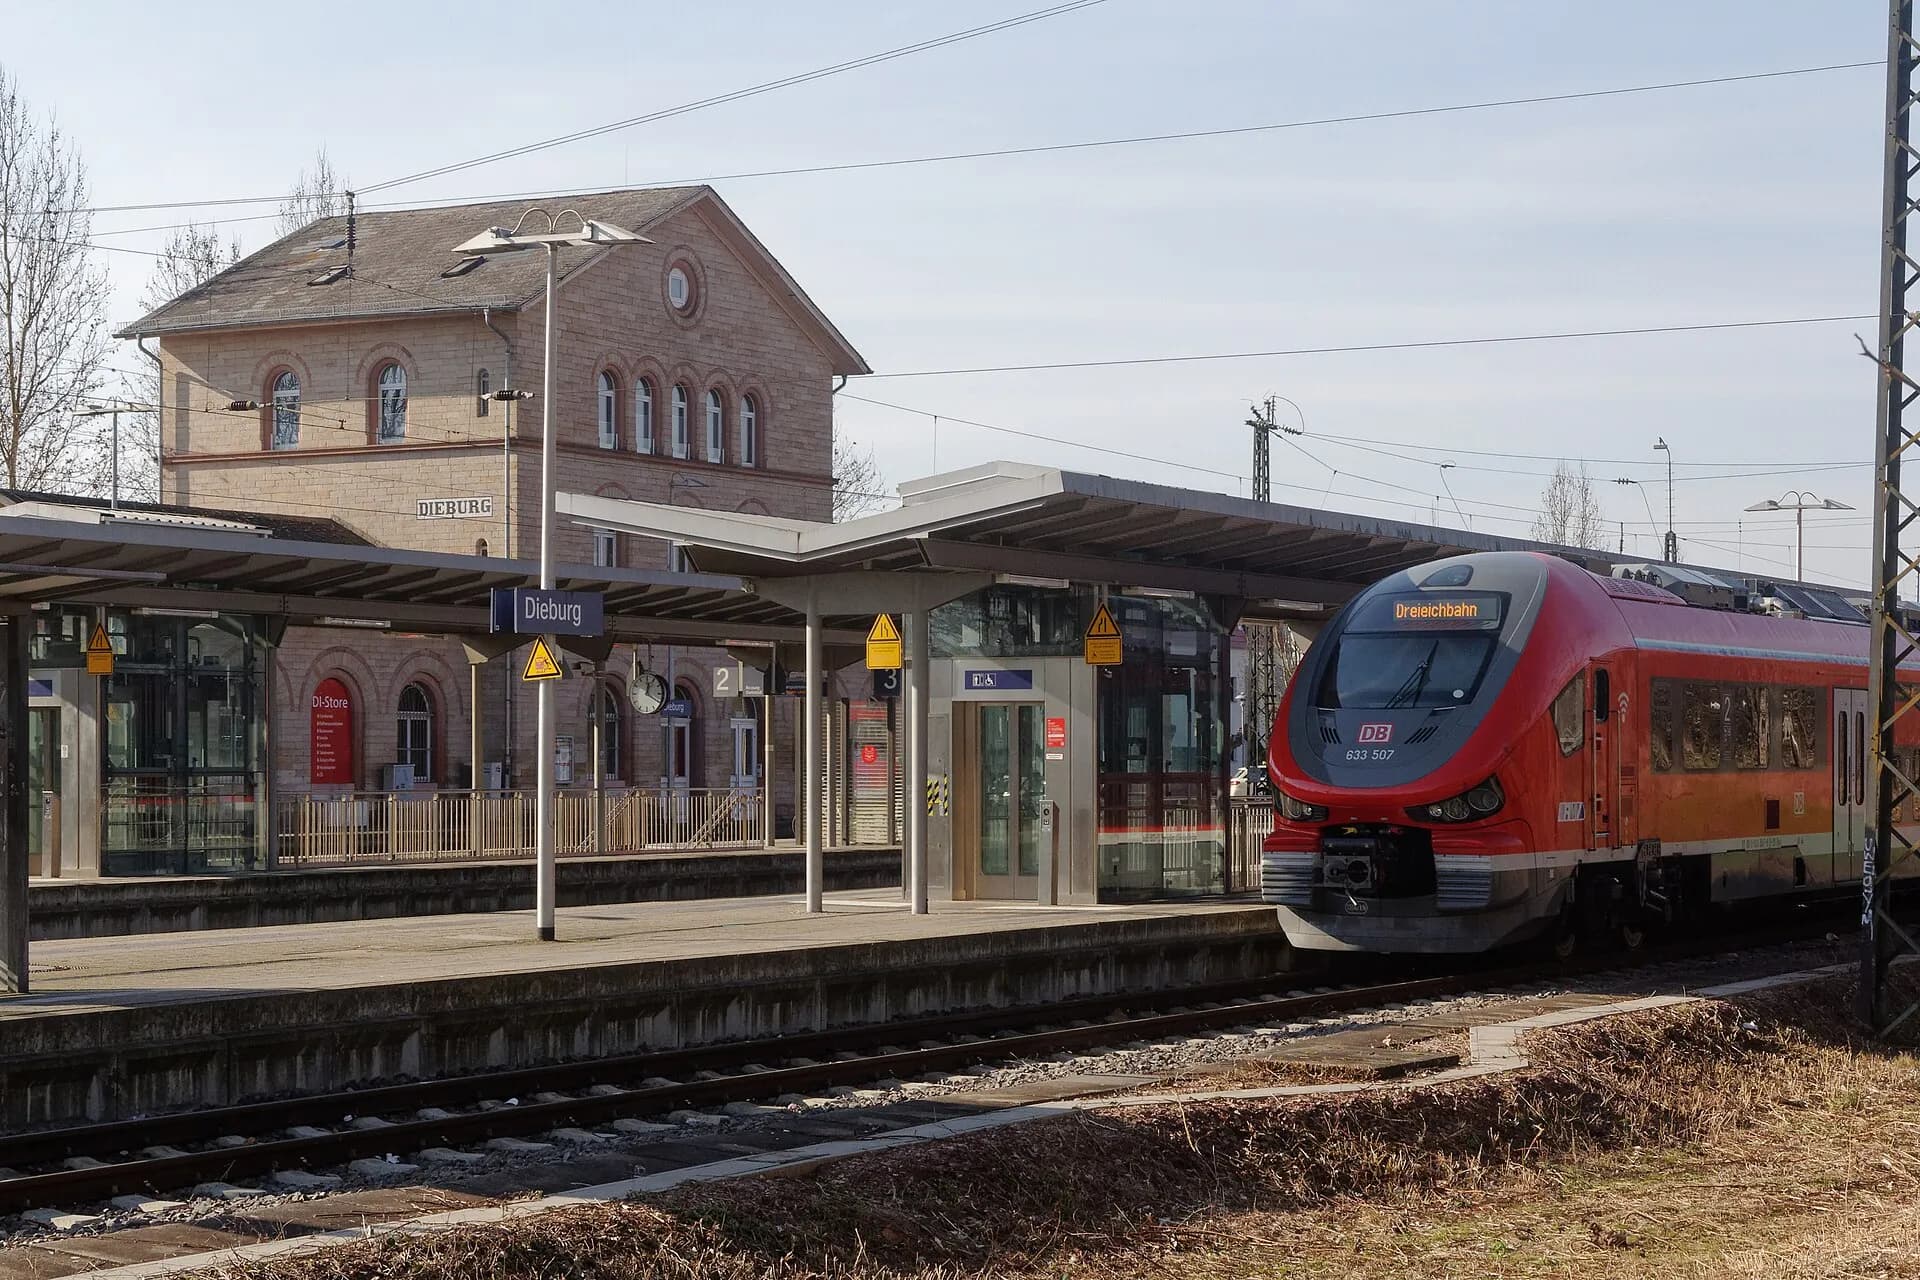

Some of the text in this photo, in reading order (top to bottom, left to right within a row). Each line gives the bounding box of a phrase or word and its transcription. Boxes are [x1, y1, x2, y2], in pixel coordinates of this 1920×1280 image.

[418, 499, 491, 516] DIEBURG
[524, 596, 582, 626] Dieburg
[1396, 603, 1478, 618] Dreieichbahn
[716, 667, 729, 691] 2
[883, 669, 898, 690] 3
[312, 696, 348, 709] DI-Store
[1724, 696, 1731, 721] 2
[1360, 725, 1390, 742] DB
[1346, 750, 1394, 760] 633 507
